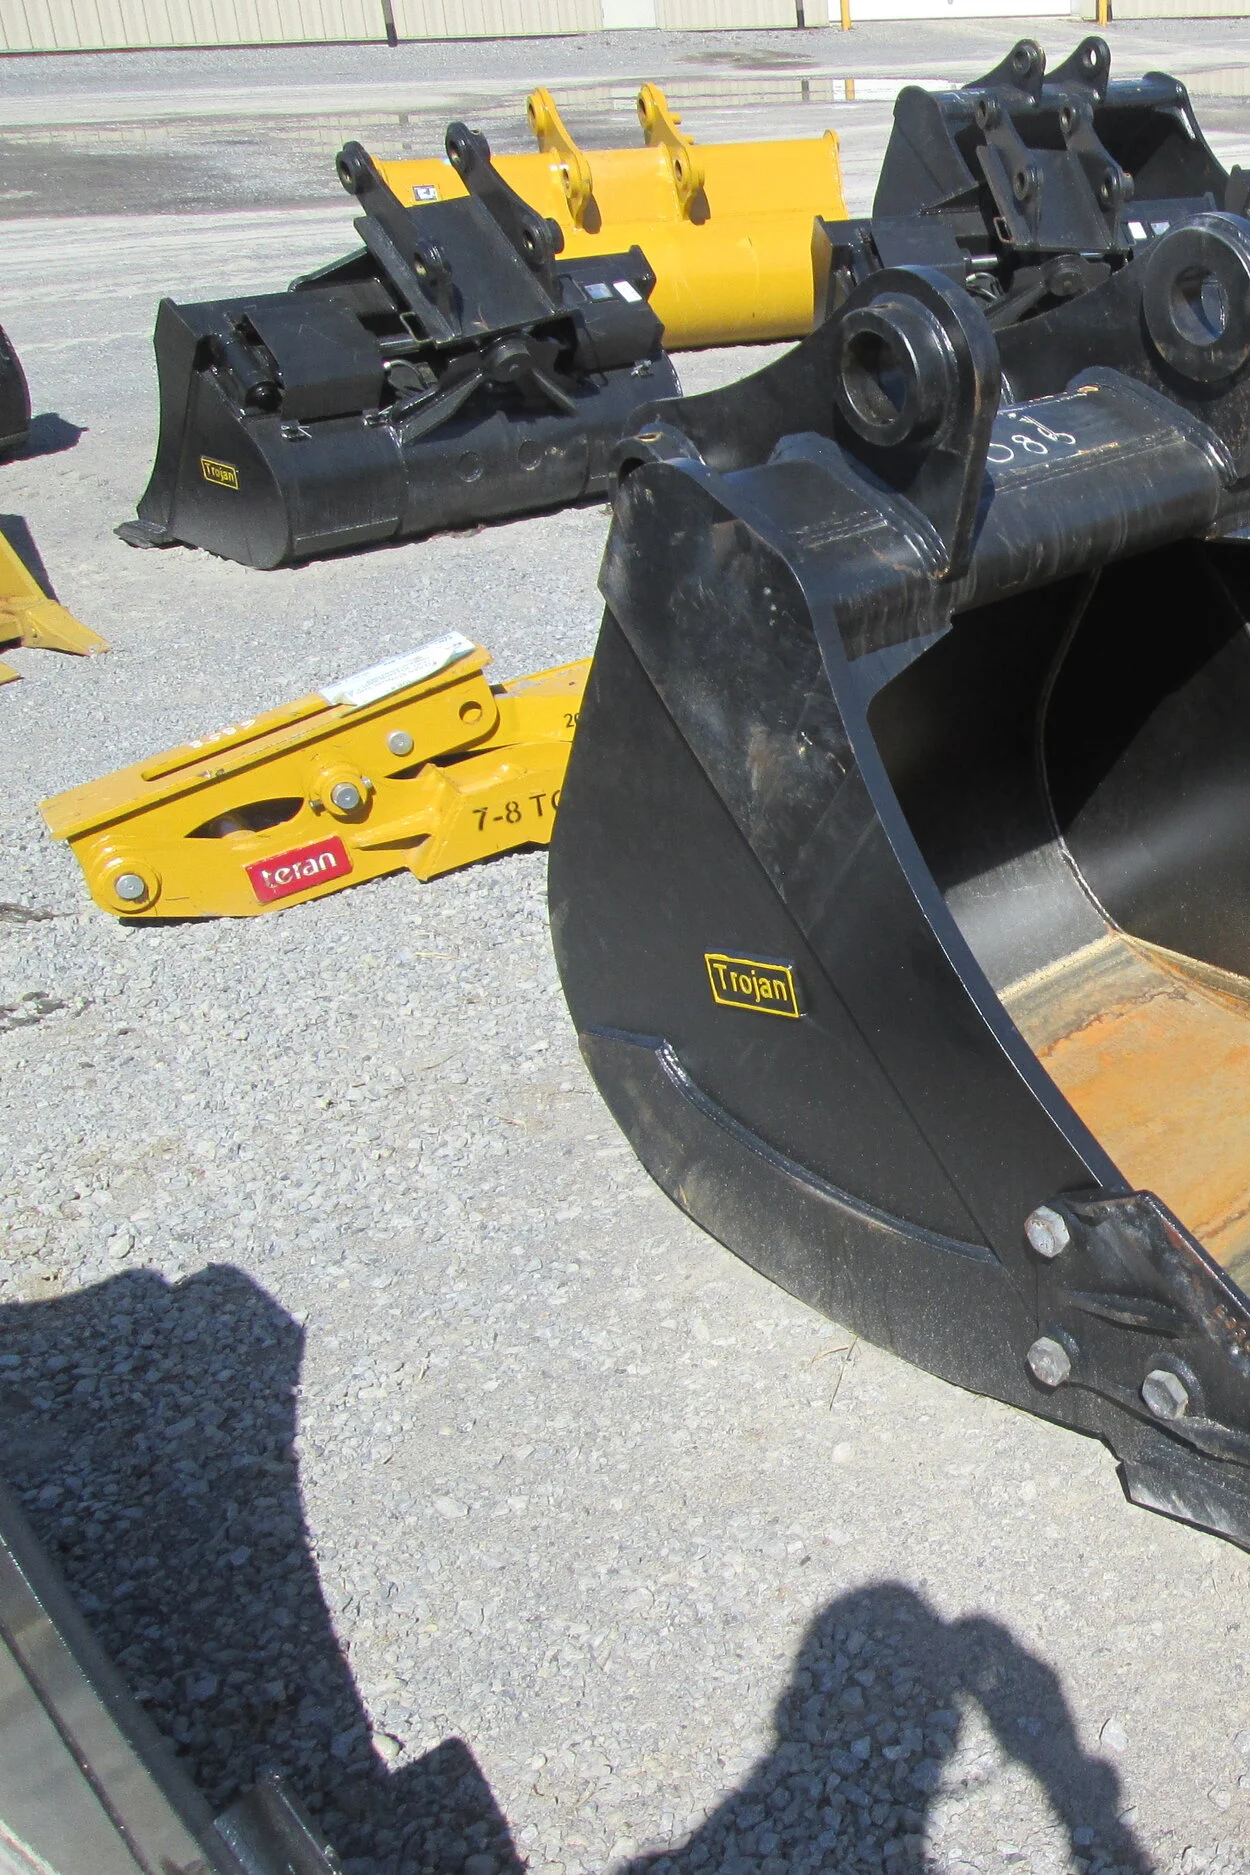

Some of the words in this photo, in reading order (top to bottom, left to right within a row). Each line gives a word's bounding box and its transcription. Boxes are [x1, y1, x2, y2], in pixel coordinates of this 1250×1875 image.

[204, 461, 236, 483] Trojan
[472, 800, 522, 832] 7-8
[260, 852, 337, 889] teran
[712, 962, 788, 1003] Trojan
